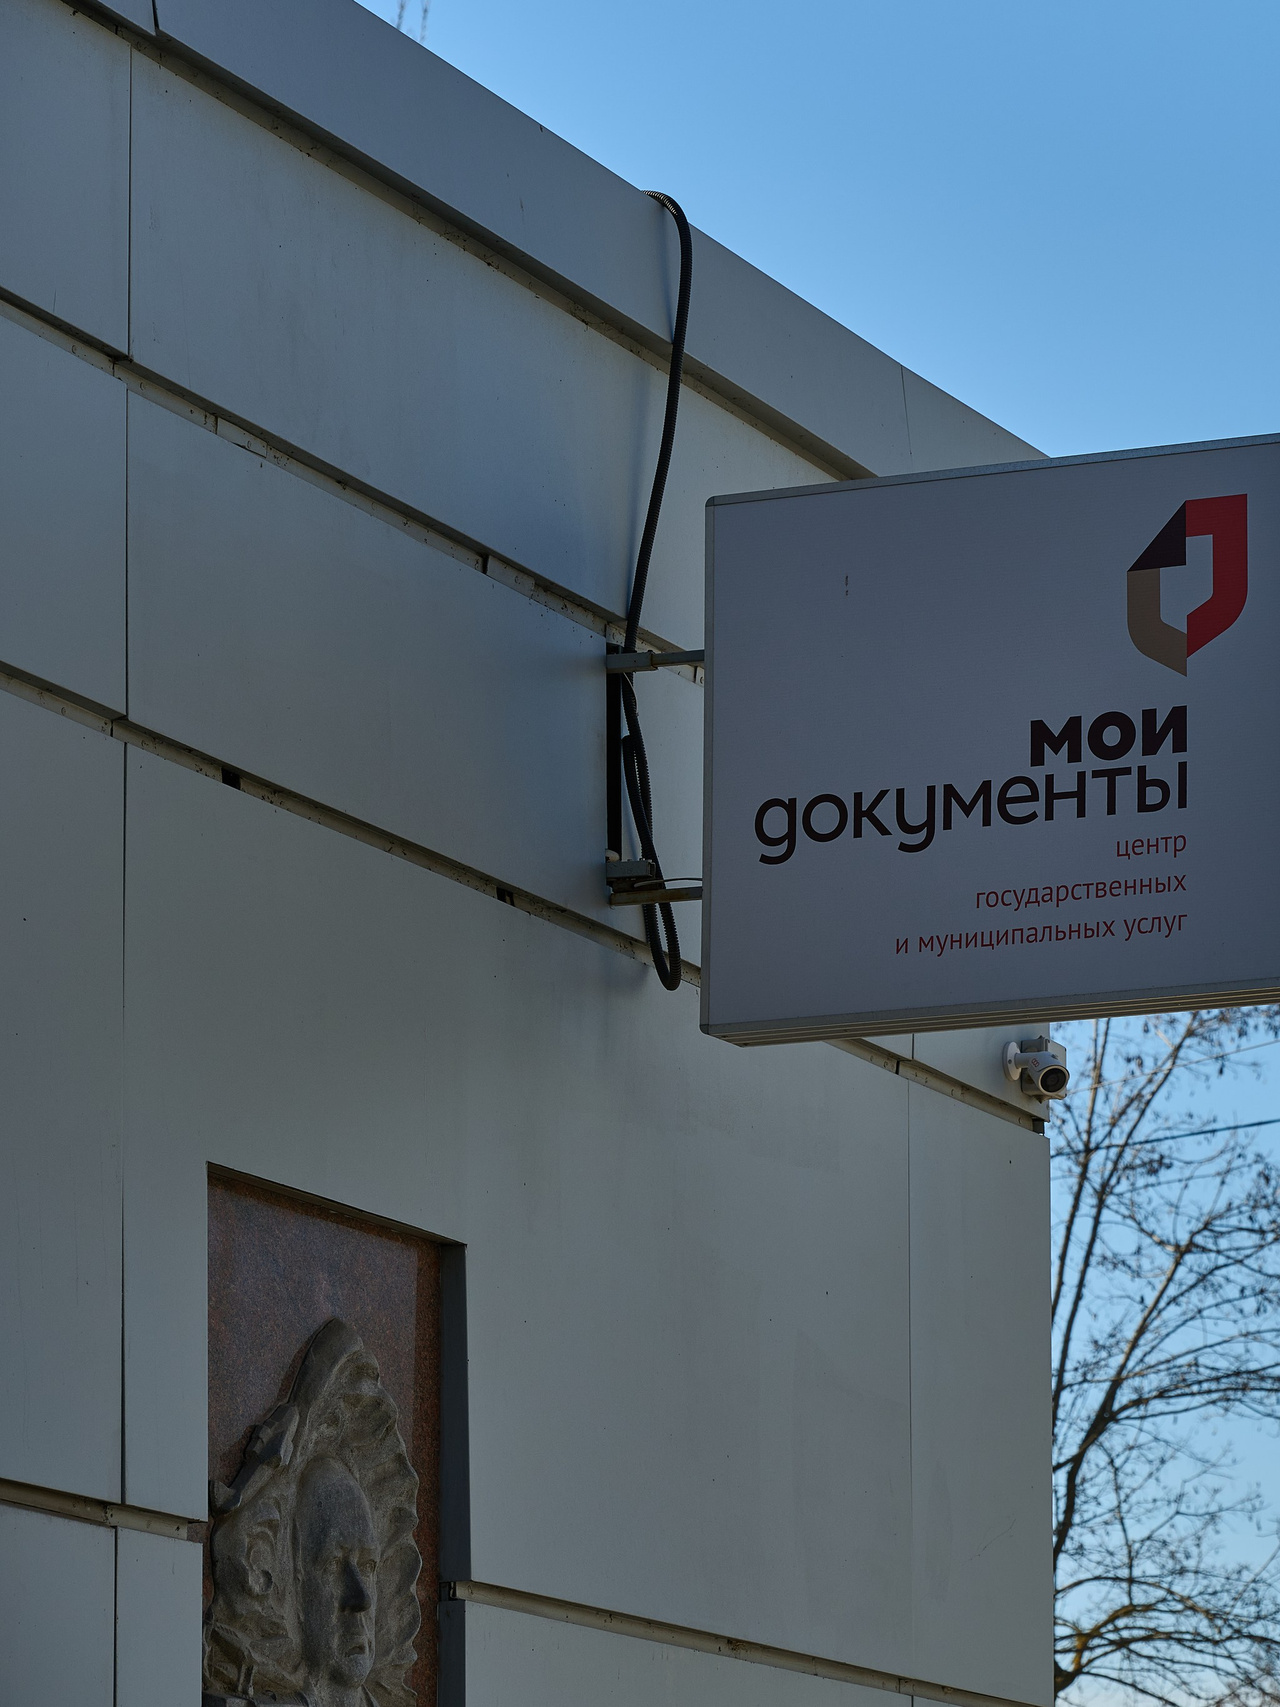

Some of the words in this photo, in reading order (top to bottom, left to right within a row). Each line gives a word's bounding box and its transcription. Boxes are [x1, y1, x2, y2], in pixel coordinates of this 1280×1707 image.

[1116, 834, 1188, 859] центр
[976, 874, 1188, 911] государственных
[896, 937, 909, 955] и
[918, 919, 1116, 958] муниципальных
[1123, 914, 1188, 942] услуг
